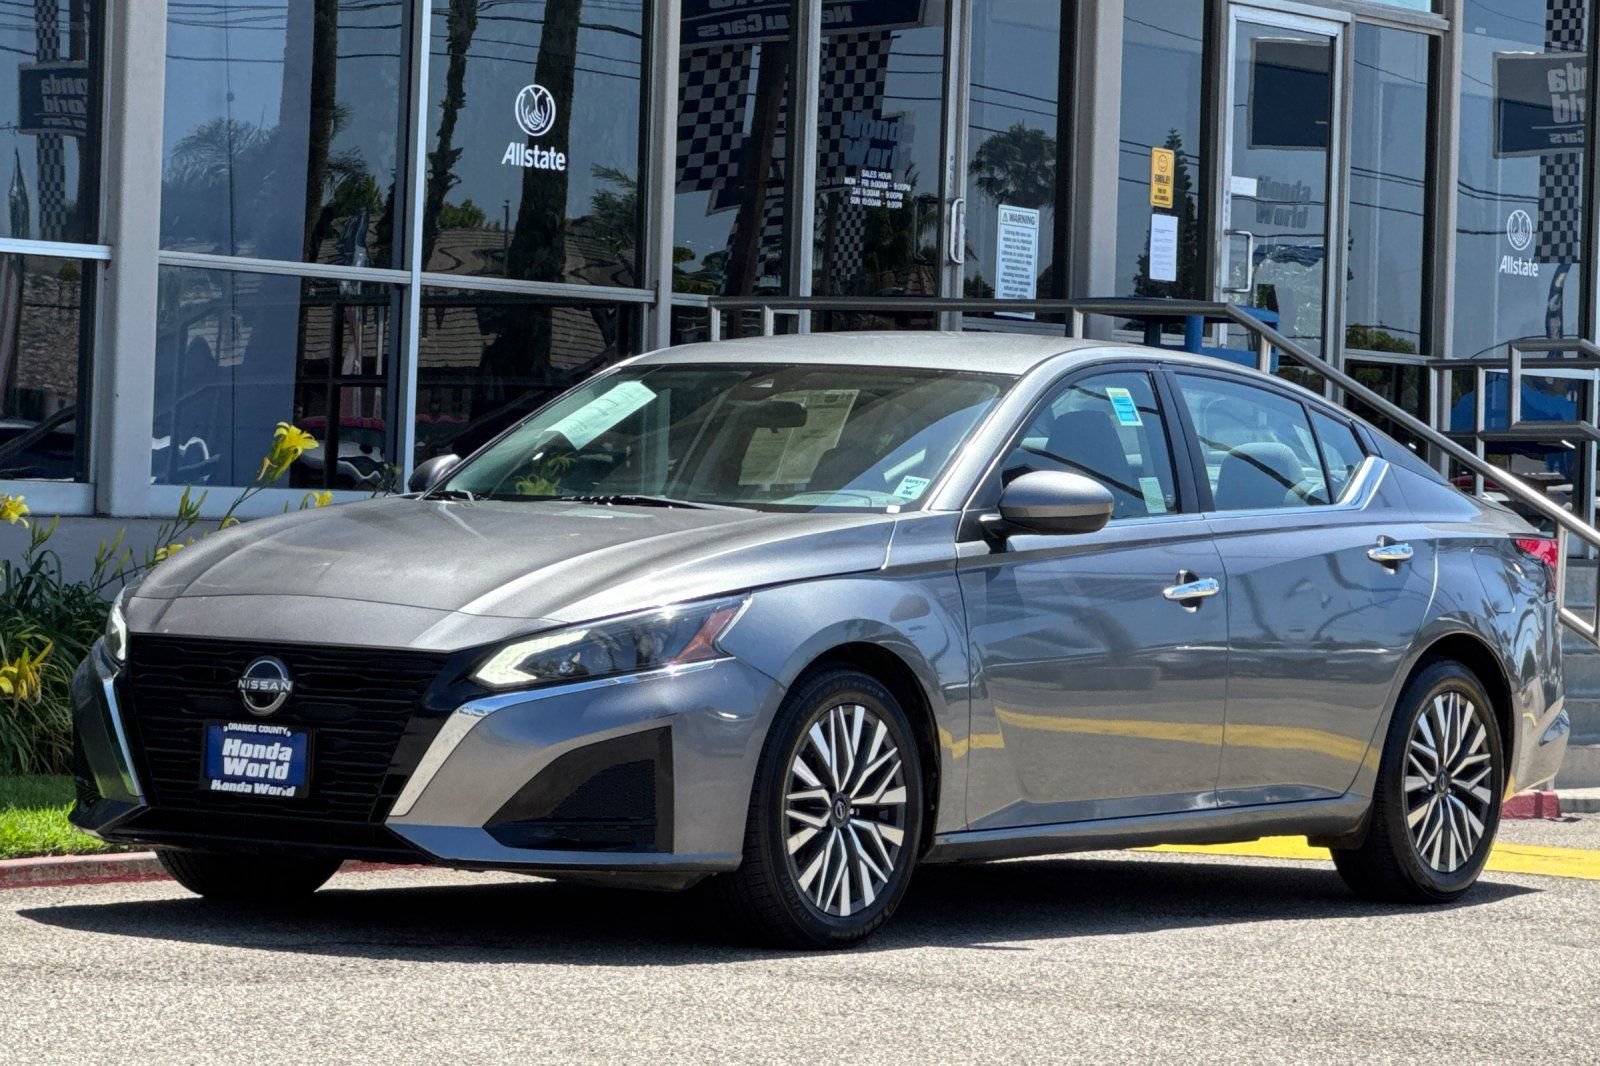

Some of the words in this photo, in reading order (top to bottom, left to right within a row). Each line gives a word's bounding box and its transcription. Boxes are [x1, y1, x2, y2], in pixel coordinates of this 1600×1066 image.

[501, 142, 566, 171] Allstate
[861, 169, 877, 179] SALES
[844, 176, 856, 185] MON
[861, 179, 869, 187] FRI
[1256, 175, 1312, 203] Honda
[850, 196, 860, 205] SUN
[1009, 212, 1036, 226] WARNING
[1256, 201, 1308, 229] World
[1499, 255, 1539, 277] Allstate
[904, 478, 927, 486] SAFETY
[238, 679, 292, 692] NISSAN
[228, 722, 257, 733] ORANGE
[258, 725, 288, 735] COUNTY
[222, 738, 293, 762] Honda
[223, 757, 290, 780] World
[211, 779, 252, 793] Honda
